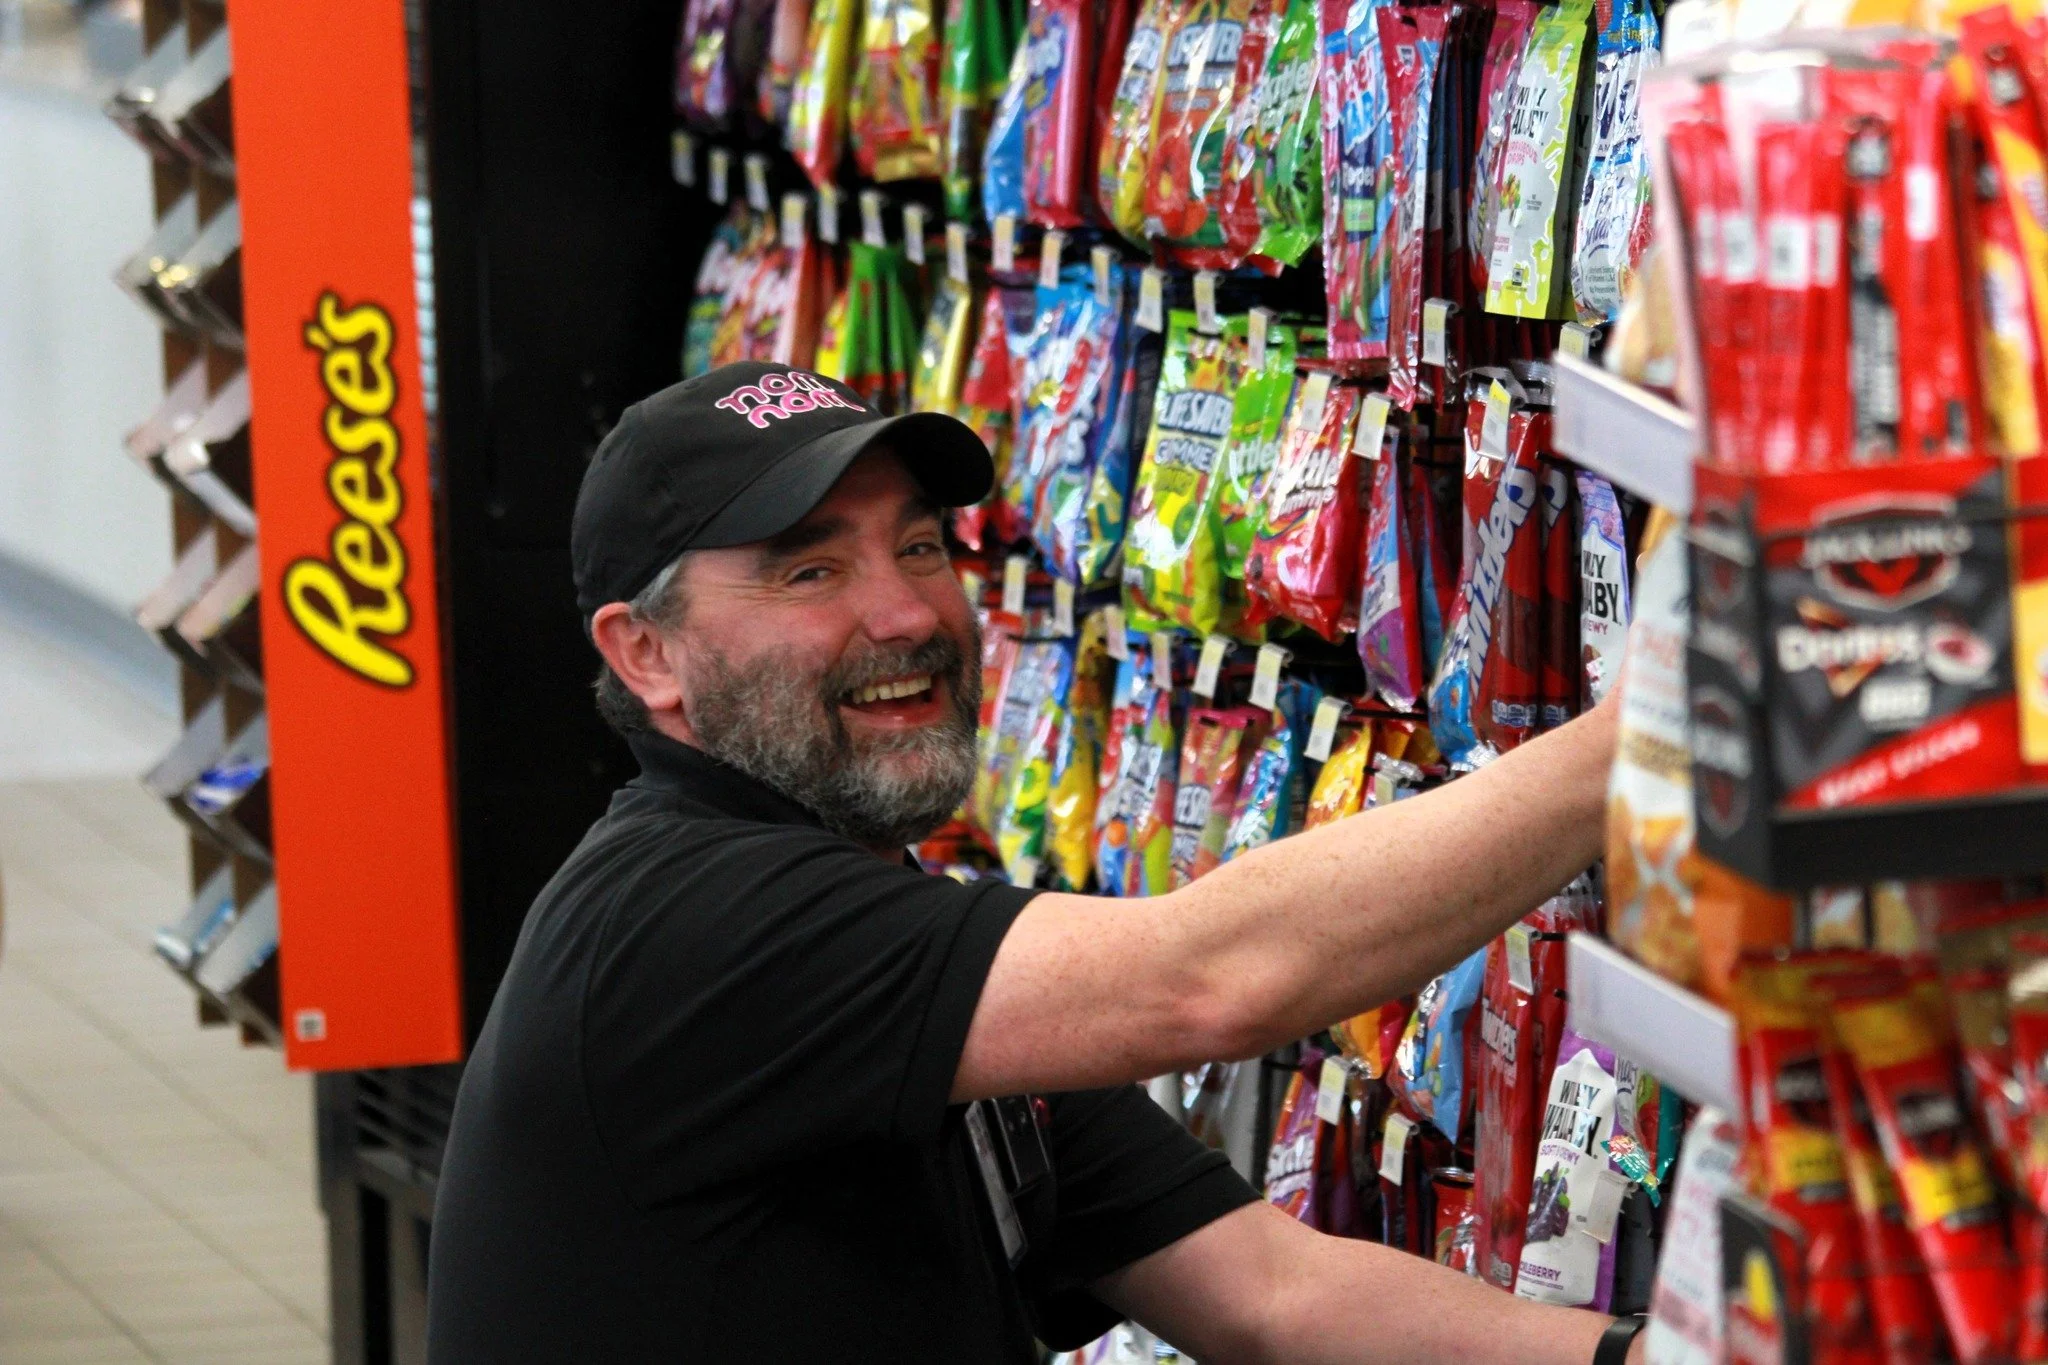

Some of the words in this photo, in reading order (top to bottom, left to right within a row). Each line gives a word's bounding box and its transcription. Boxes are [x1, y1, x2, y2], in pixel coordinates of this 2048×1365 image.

[715, 371, 835, 414] nom
[747, 389, 867, 428] nom
[285, 293, 411, 687] Reese's
